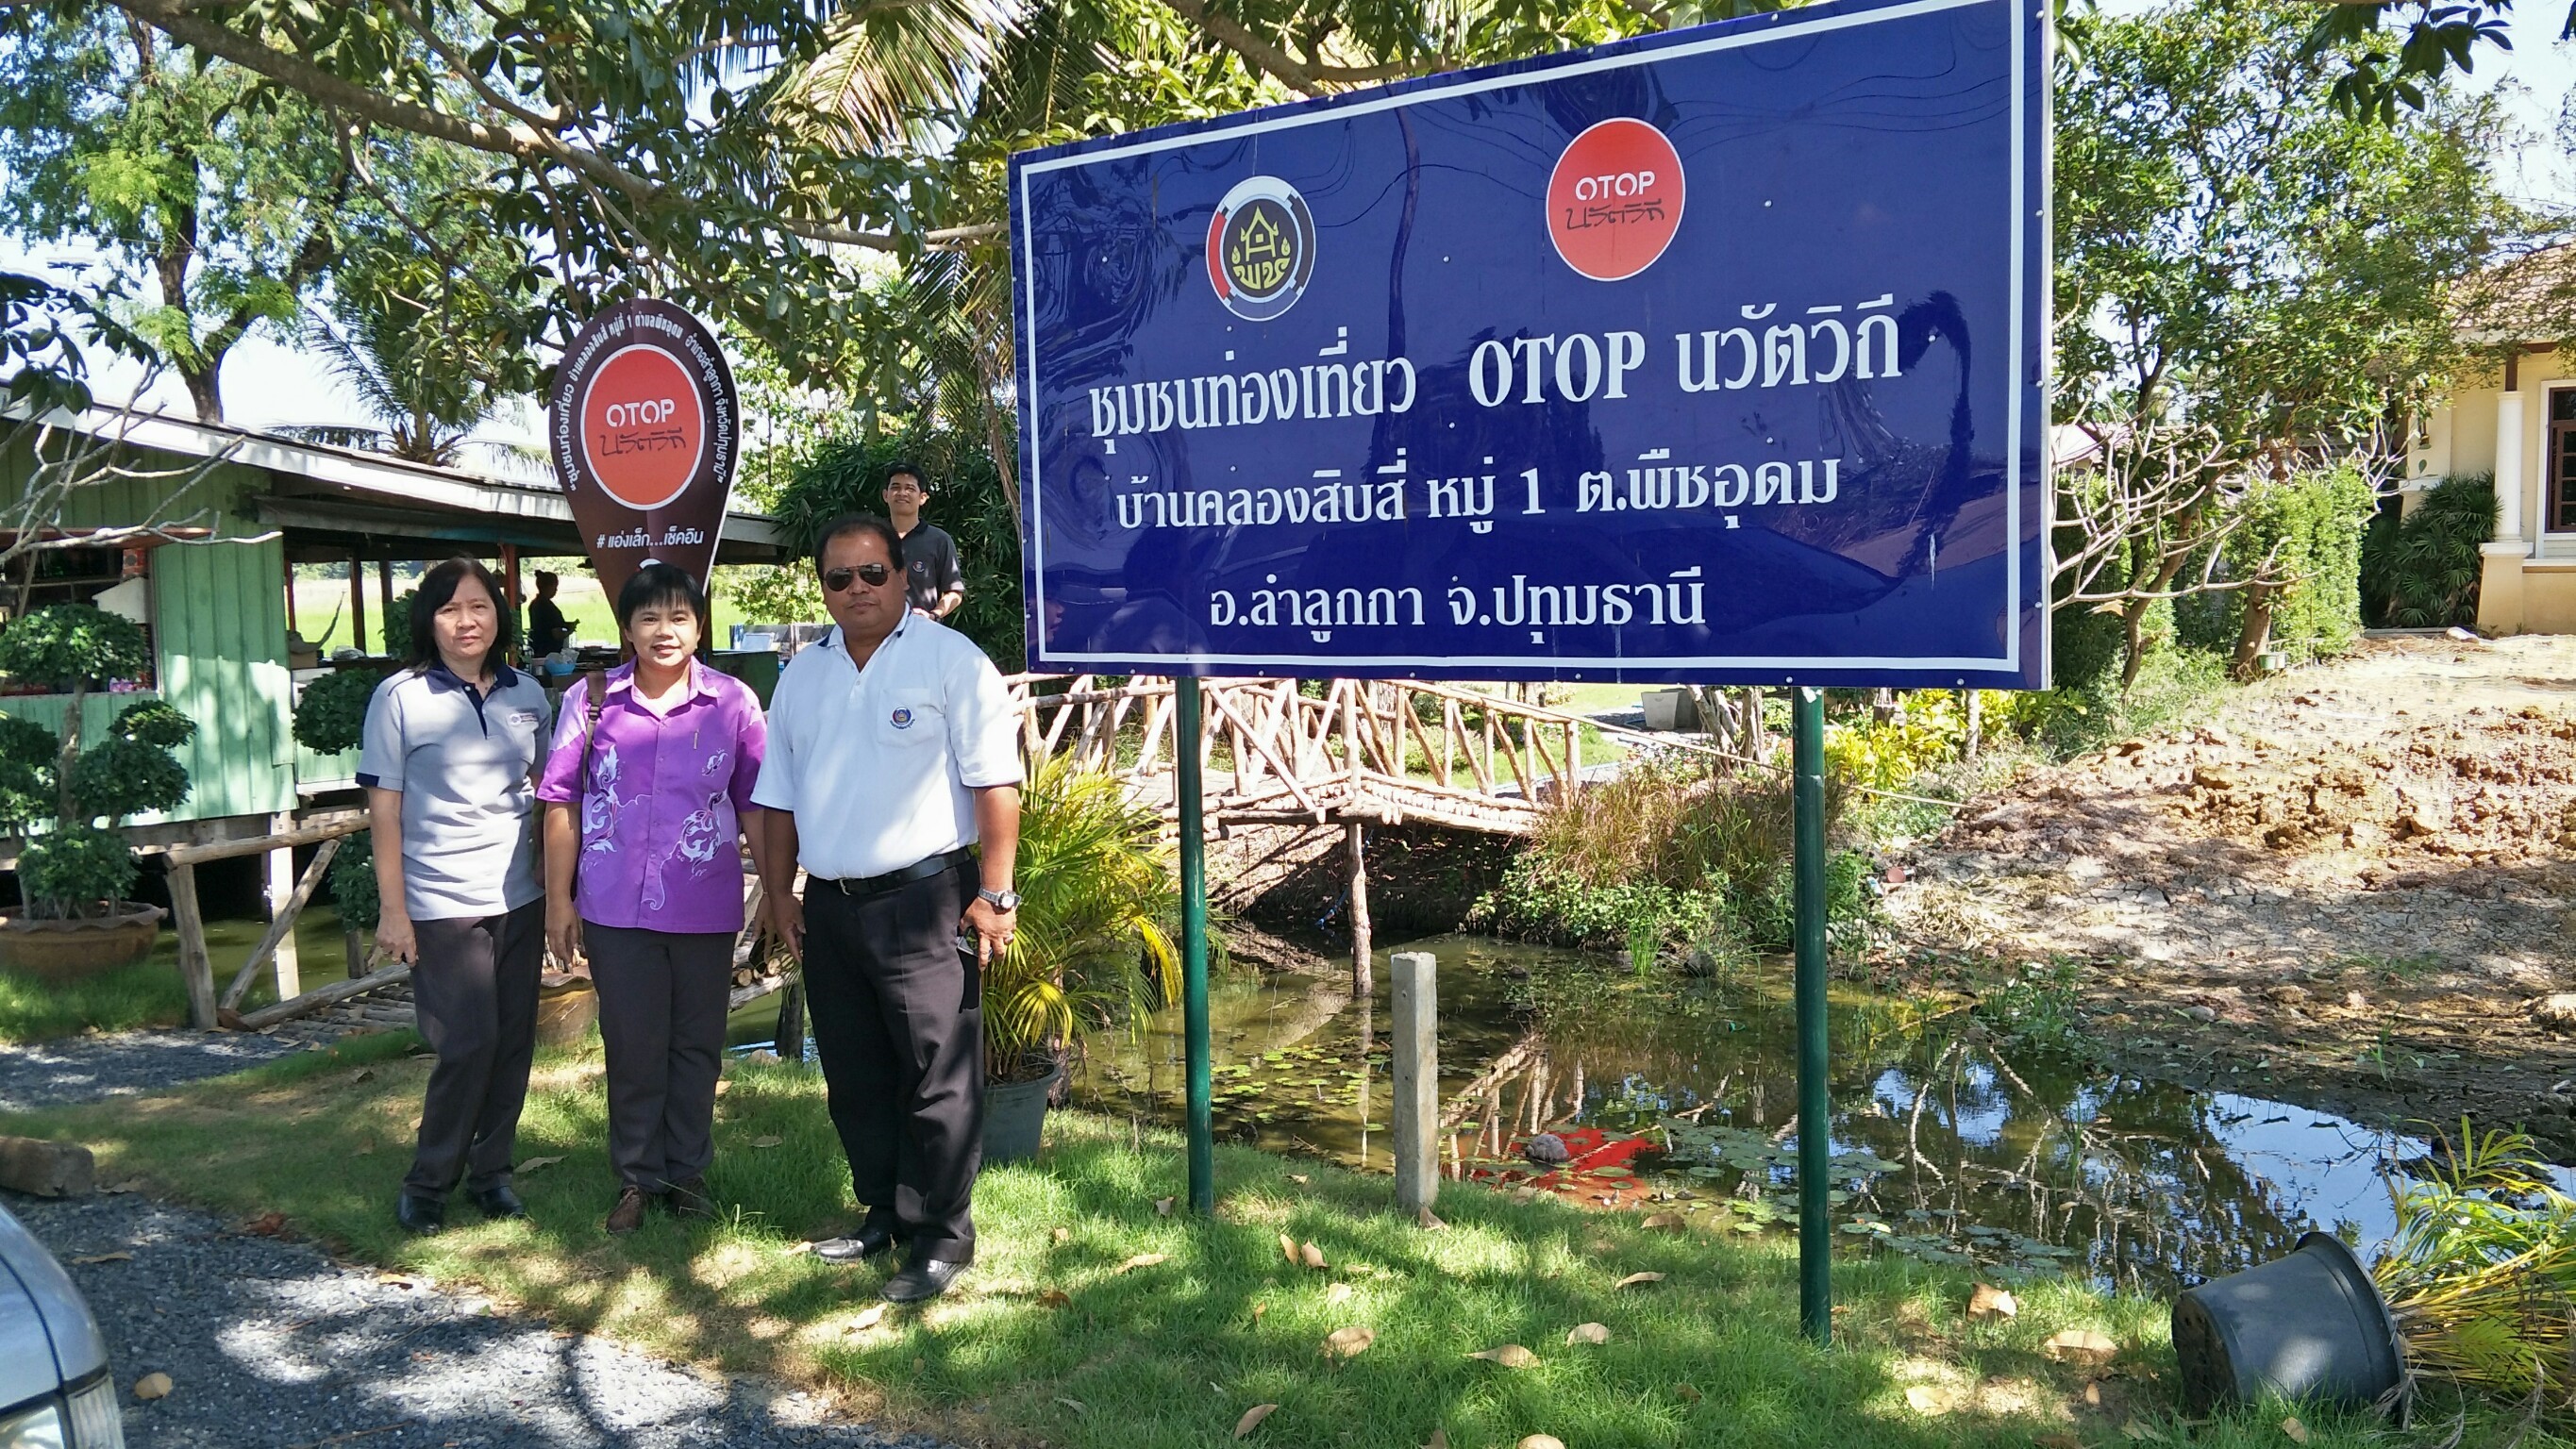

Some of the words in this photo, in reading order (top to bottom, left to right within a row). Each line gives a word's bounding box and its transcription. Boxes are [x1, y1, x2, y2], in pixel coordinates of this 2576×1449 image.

[1575, 171, 1656, 201] OTOP
[627, 314, 632, 328] 1
[1089, 326, 1416, 455] ชุมชนท่องเที่ยว
[1469, 330, 1646, 408] OTOP
[1675, 293, 1903, 393] นวัตวิถี
[606, 398, 676, 427] OTOP
[1116, 447, 1407, 528] บ้านคลองสิบสี่
[1427, 456, 1496, 534] หมู่
[1520, 467, 1547, 515] 1
[1576, 447, 1842, 529] ต.พืชอุดม
[1211, 574, 1426, 642] อ.ลำลูกกา
[1447, 566, 1706, 644] จ.ปทุมธานี
